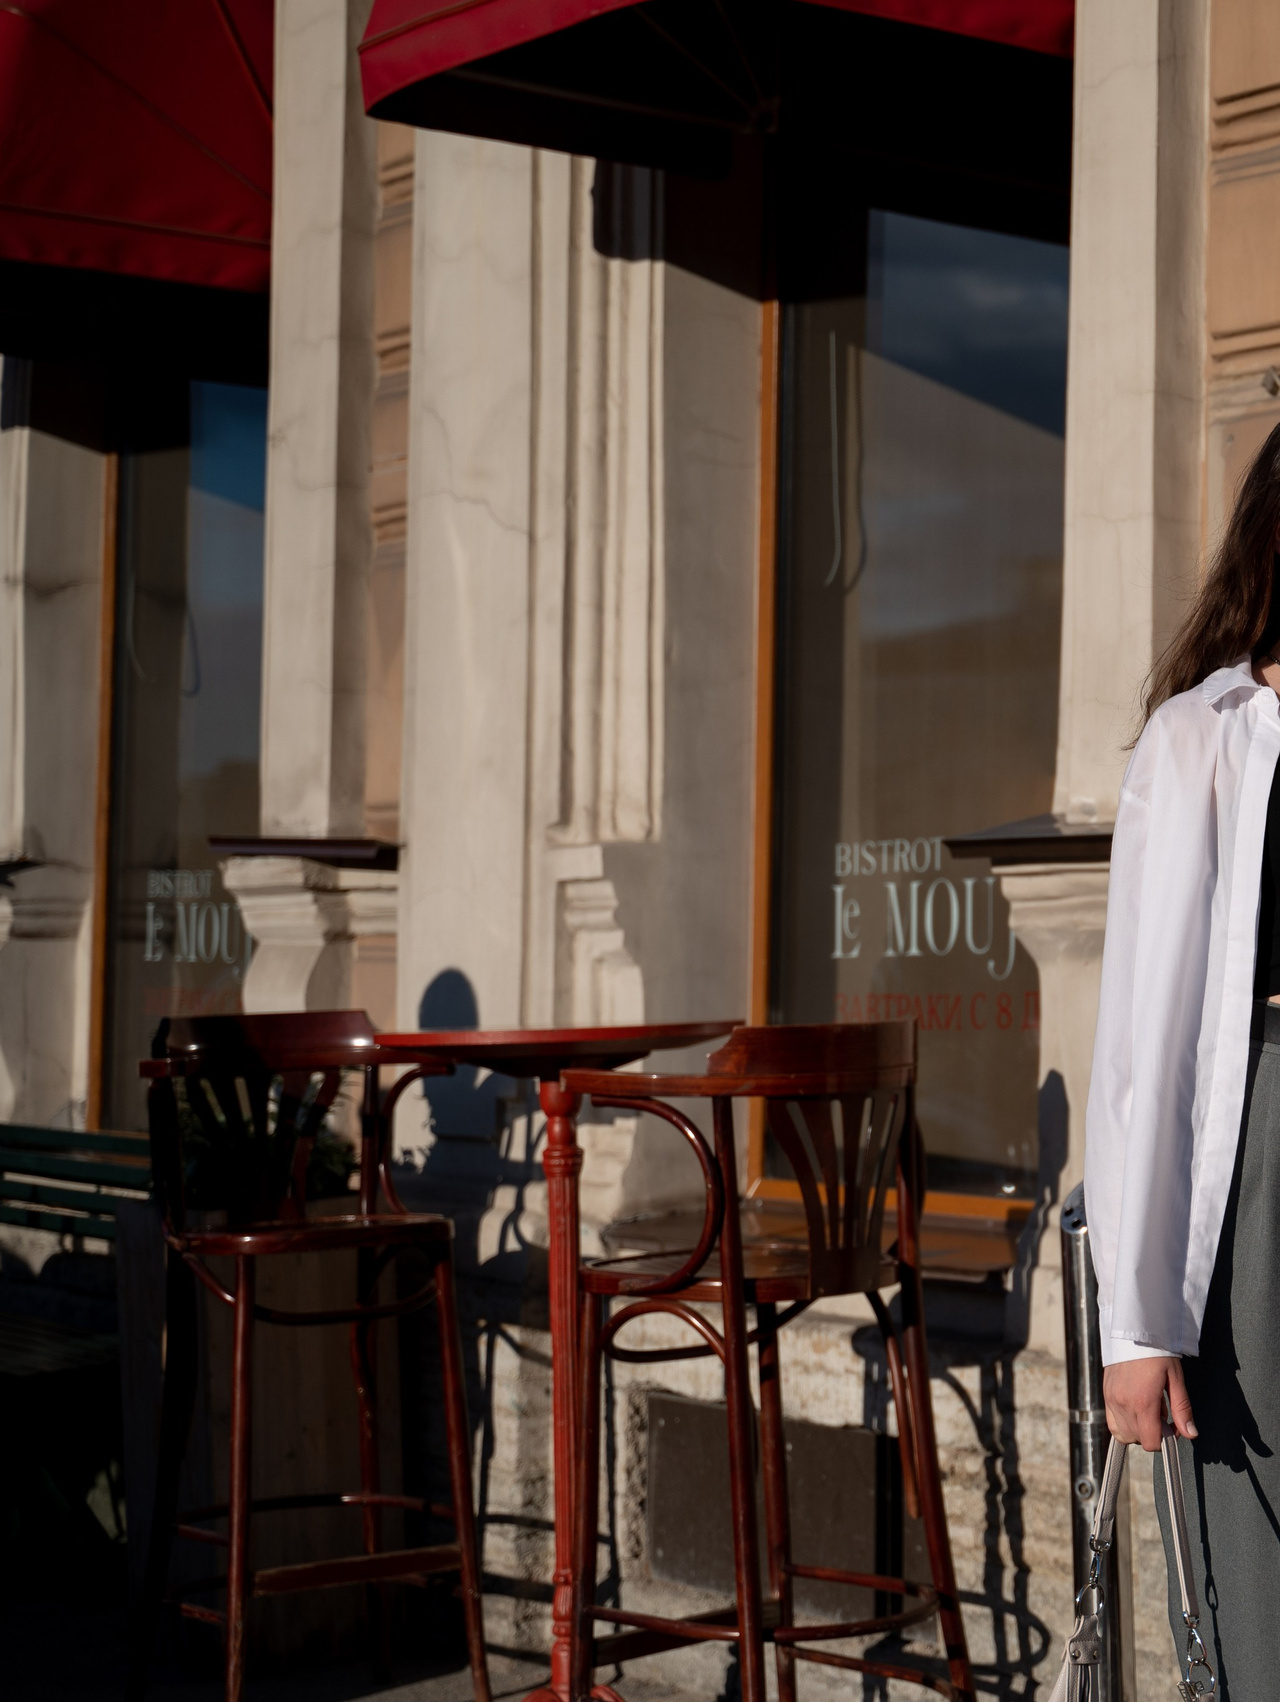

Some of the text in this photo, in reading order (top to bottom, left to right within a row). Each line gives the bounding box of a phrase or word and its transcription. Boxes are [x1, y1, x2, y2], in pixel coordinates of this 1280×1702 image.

[834, 836, 944, 877] BISTROT
[147, 868, 214, 898] BISTROT
[969, 990, 988, 1031] С
[994, 990, 1014, 1032] 8
